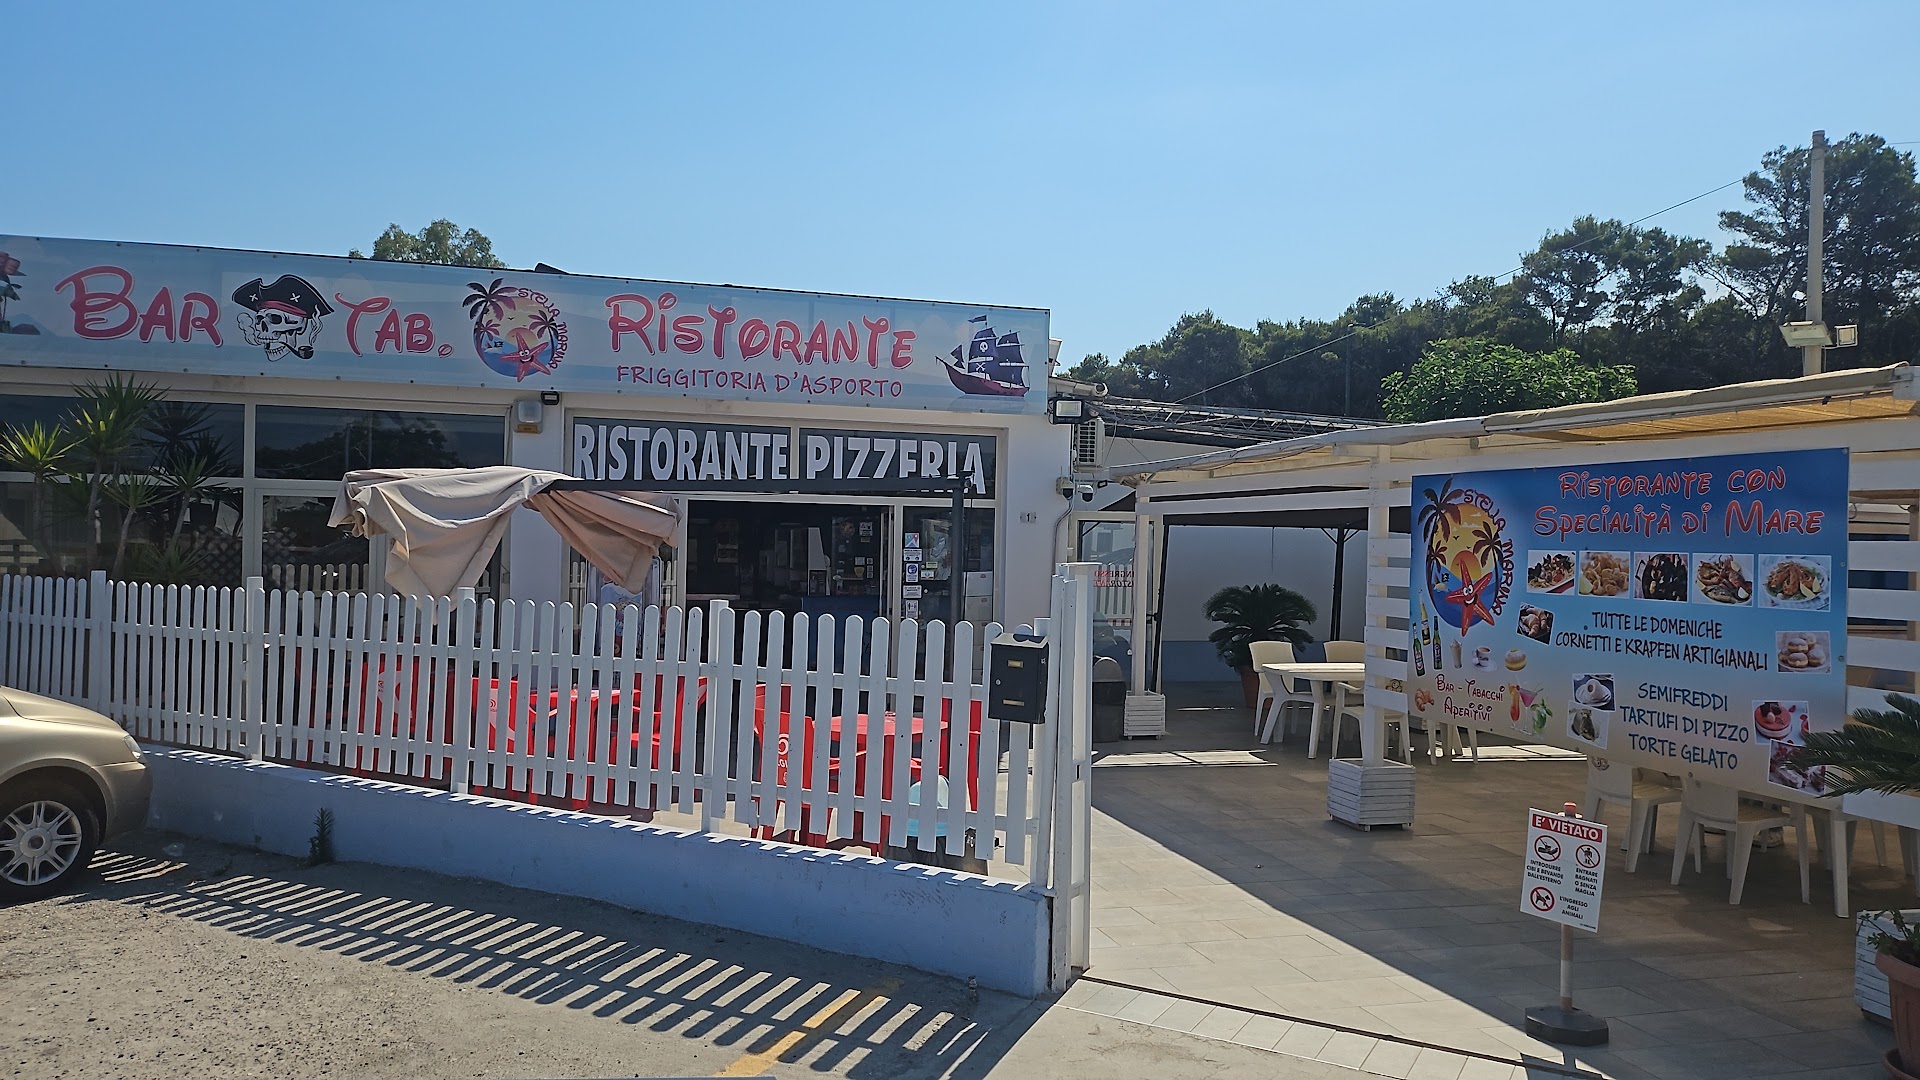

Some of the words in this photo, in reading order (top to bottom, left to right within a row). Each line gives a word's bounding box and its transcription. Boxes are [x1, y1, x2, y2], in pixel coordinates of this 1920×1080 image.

[616, 364, 767, 394] FRIGGITORIA
[774, 371, 903, 398] D'ASPORTO
[574, 423, 789, 480] RISTORANTE
[806, 435, 987, 494] PIZZERIA
[1592, 611, 1632, 631] TUTTE
[1634, 615, 1649, 632] LE
[1650, 617, 1723, 639] DOMENICHE
[1555, 631, 1612, 651] CORNETTI
[1614, 636, 1623, 652] E
[1625, 638, 1680, 659] KRAPFEN
[1682, 644, 1768, 671] ARTIGIANALI
[1638, 683, 1728, 711] SEMIFREDDI
[1620, 706, 1679, 732] TARTUFI
[1682, 716, 1698, 734] DI
[1702, 720, 1749, 743] PIZZO
[1628, 733, 1678, 758] TORTE
[1681, 745, 1738, 770] GELATO
[1549, 818, 1599, 840] VIETATO
[1530, 860, 1561, 872] INTRODURRE
[1527, 872, 1561, 885] DALL'ESTERNO
[1541, 869, 1564, 880] BEVANDE
[1575, 874, 1598, 884] BAGNATI
[1576, 868, 1598, 878] ENTRARE
[1580, 881, 1597, 890] SENZA
[1575, 887, 1595, 897] MAGLIA
[1559, 896, 1588, 908] L'INGRESSO
[1567, 904, 1580, 912] AGLI
[1561, 910, 1583, 920] ANIMALI
